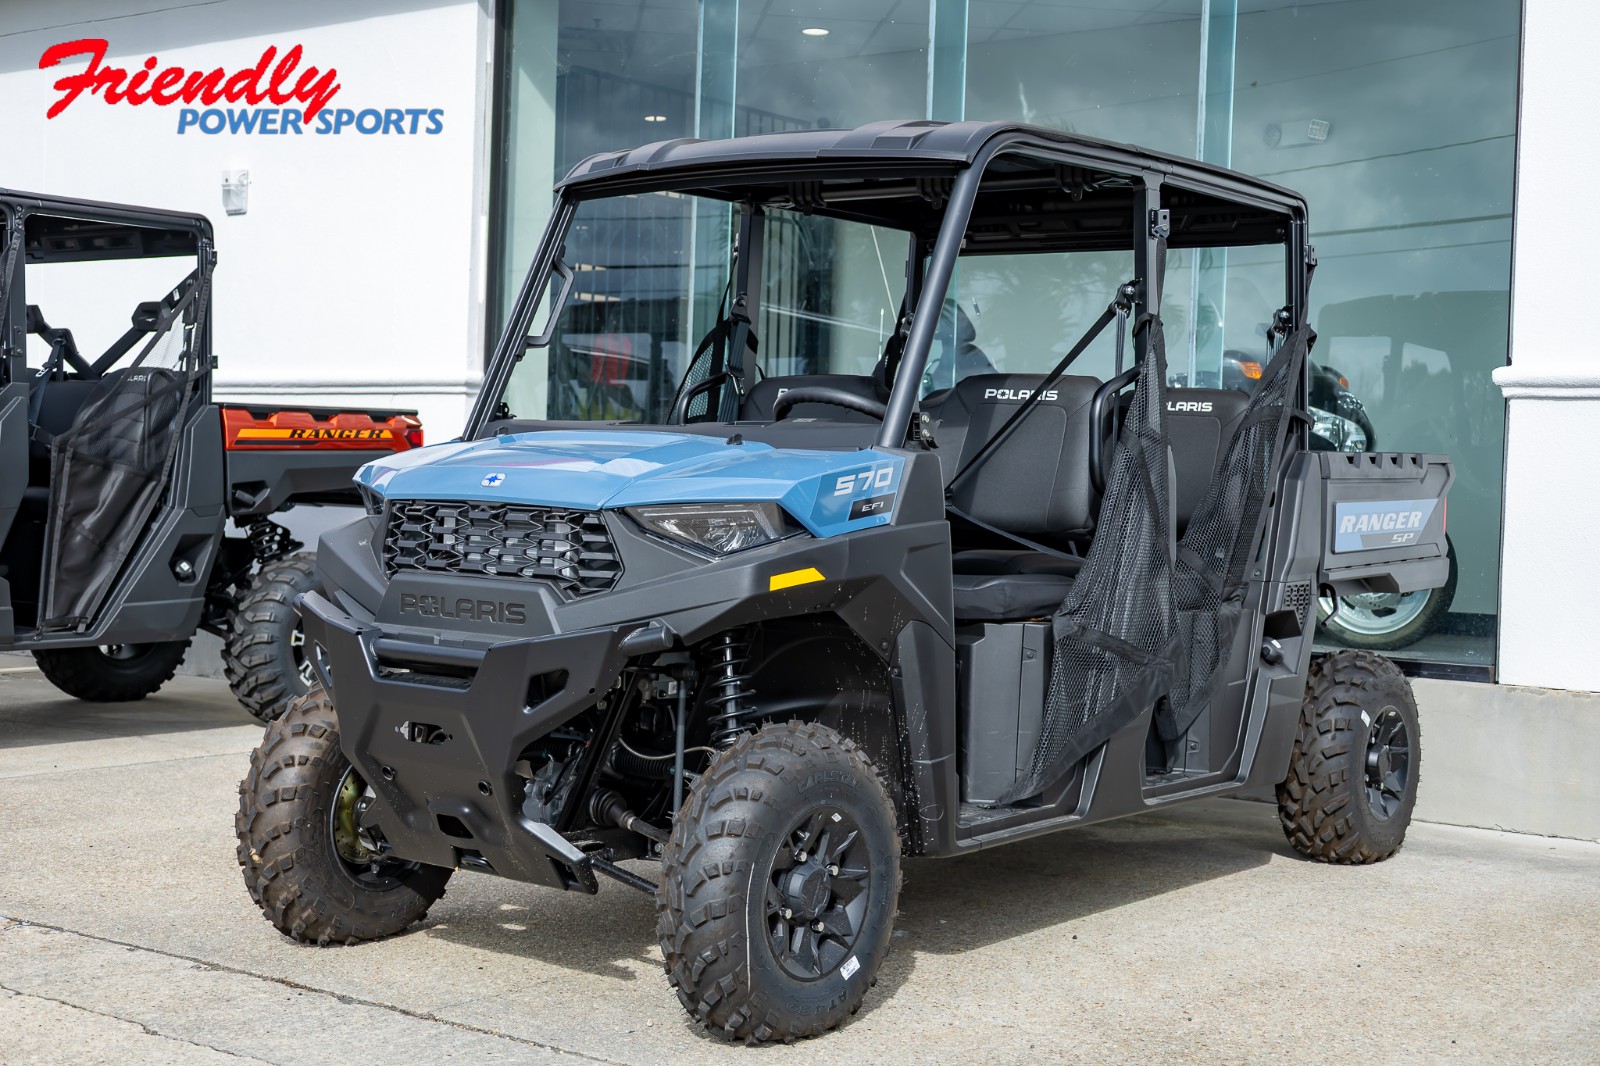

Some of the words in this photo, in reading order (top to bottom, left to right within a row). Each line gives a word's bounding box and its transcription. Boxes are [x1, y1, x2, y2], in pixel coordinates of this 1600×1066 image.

[1166, 401, 1213, 412] LARIS
[289, 429, 384, 438] RANGER
[861, 501, 884, 512] EFI
[1339, 511, 1423, 533] RANGER
[1391, 532, 1415, 544] SP
[400, 593, 527, 625] POLARIS
